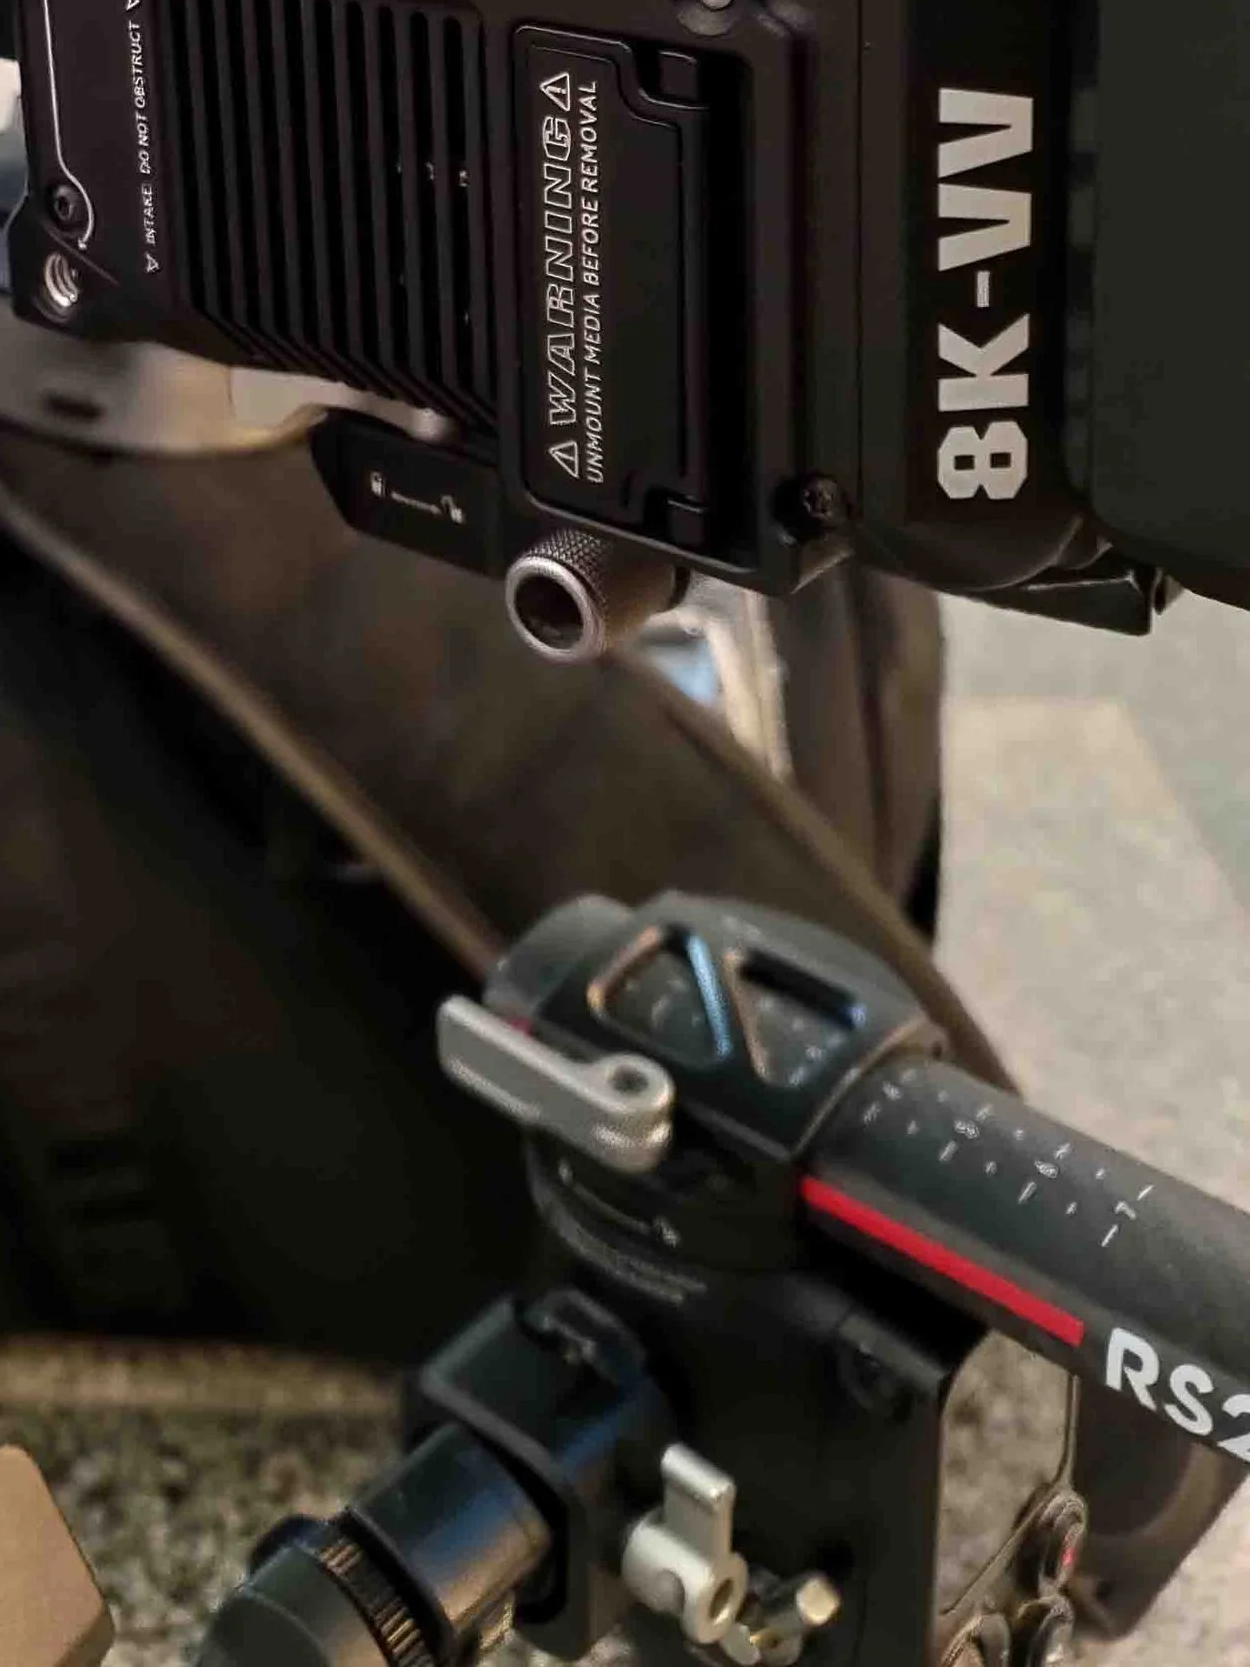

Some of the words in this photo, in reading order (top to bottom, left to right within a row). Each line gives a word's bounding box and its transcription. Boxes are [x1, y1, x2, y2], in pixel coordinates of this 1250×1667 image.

[128, 20, 147, 109] OBSTRUCT
[137, 112, 150, 147] NOT
[140, 151, 152, 174] DO
[579, 81, 598, 192] REMOVAL
[143, 184, 157, 246] INTAKE
[581, 199, 600, 286] BEFORE
[542, 116, 577, 428] WARNING
[582, 292, 602, 364] MEDIA
[585, 366, 605, 483] UNMOUNT
